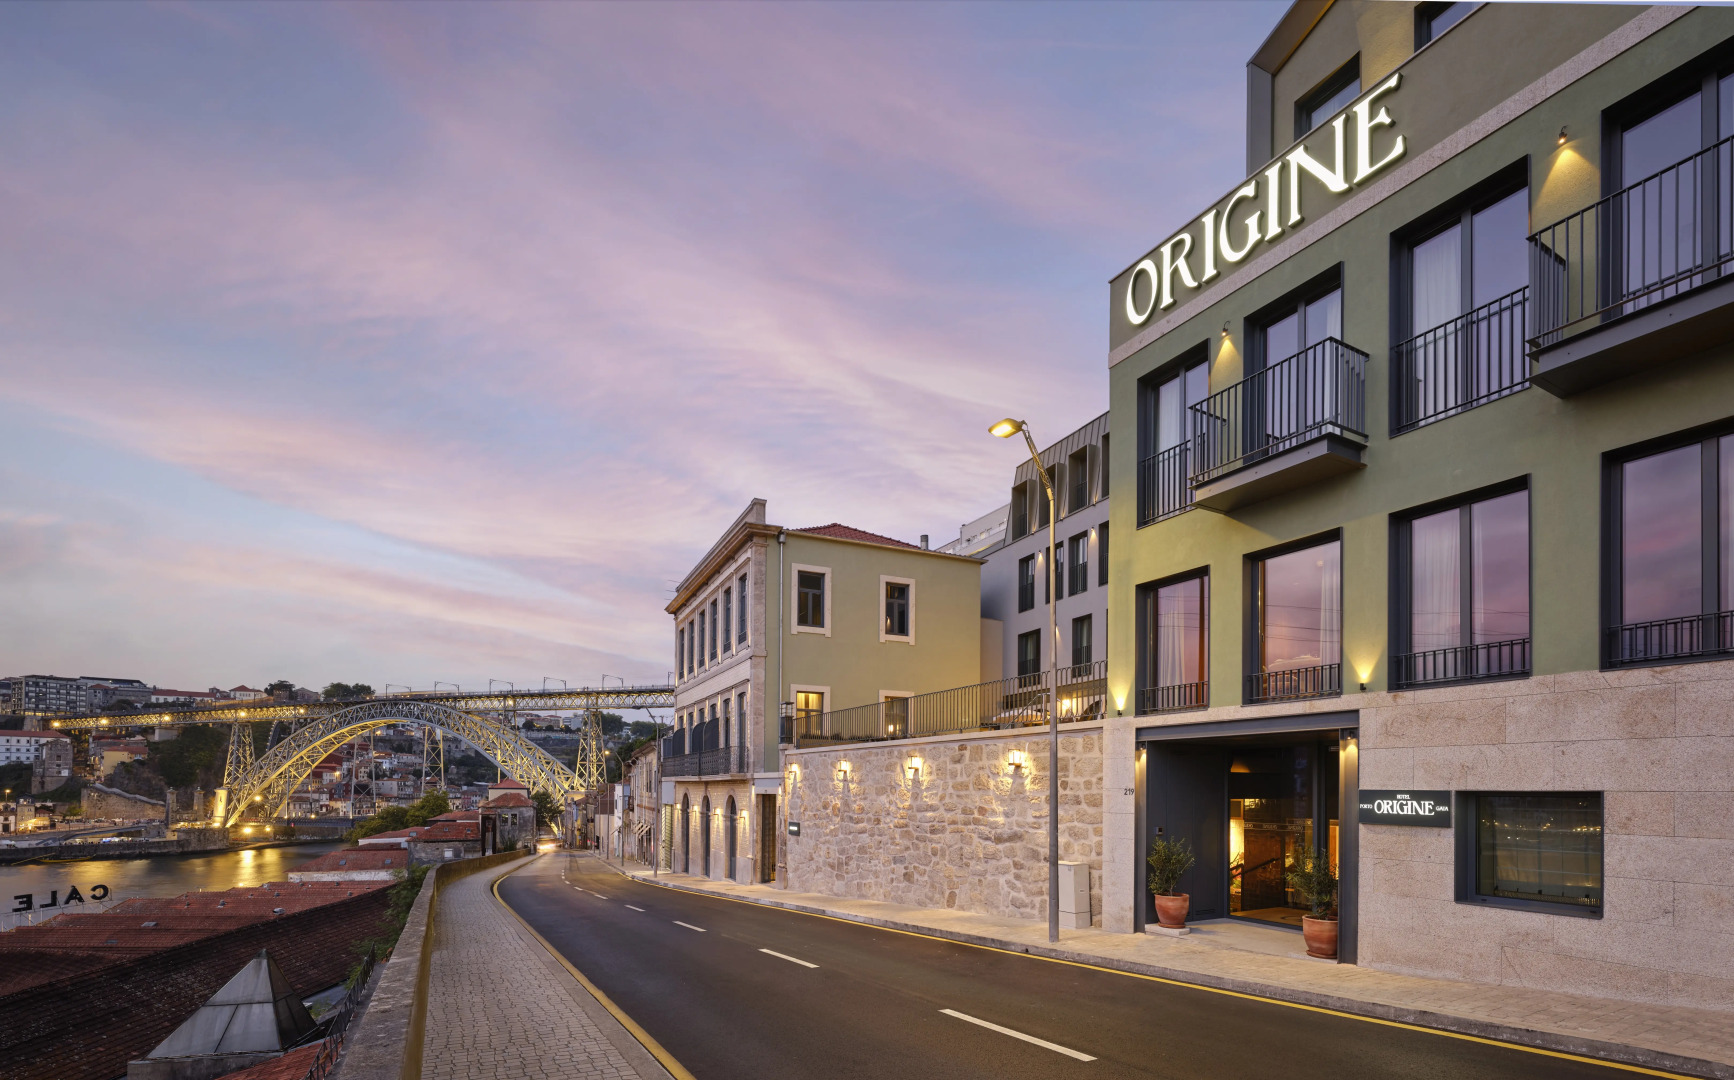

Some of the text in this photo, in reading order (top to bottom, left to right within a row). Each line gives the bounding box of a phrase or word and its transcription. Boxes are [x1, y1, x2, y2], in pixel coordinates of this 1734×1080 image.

[1126, 72, 1407, 325] ORIGINE
[1124, 788, 1135, 796] 219
[1374, 799, 1435, 816] ORIGINE
